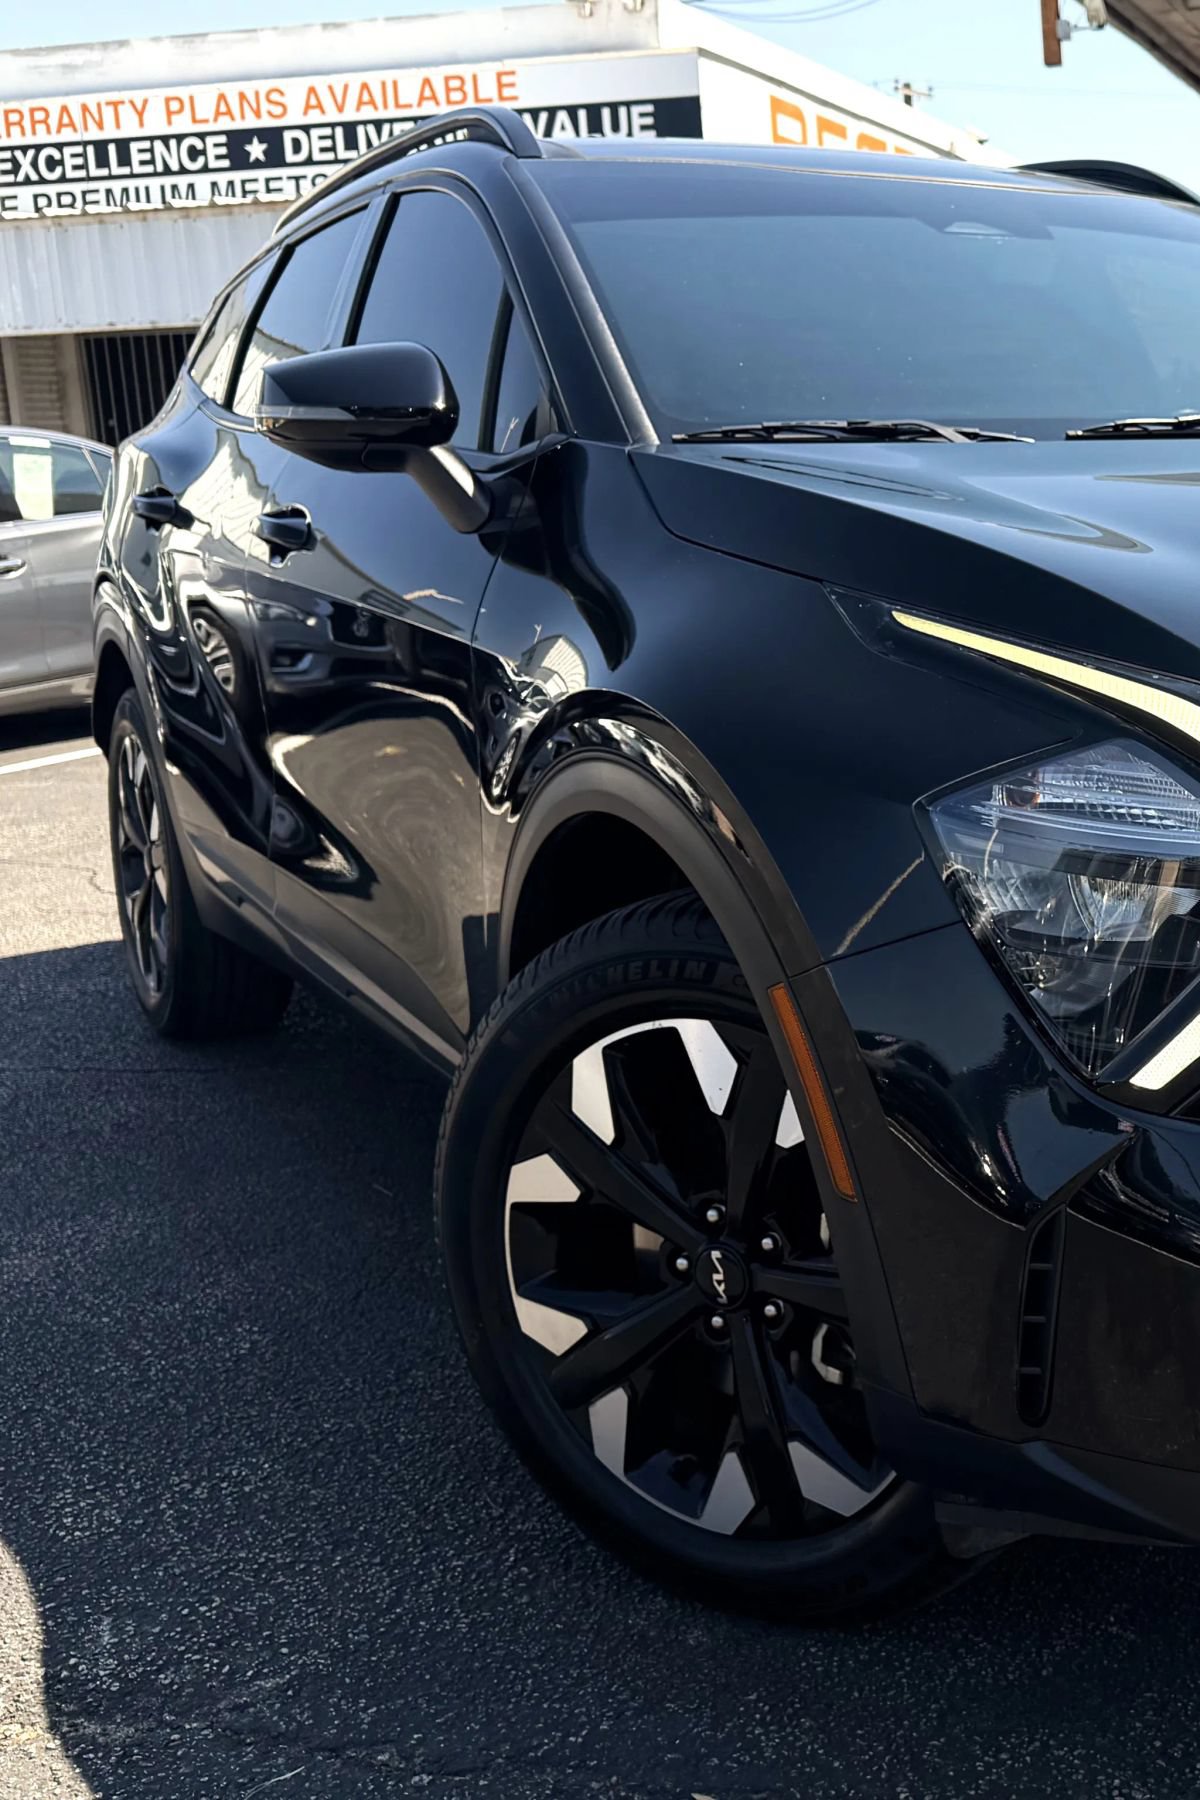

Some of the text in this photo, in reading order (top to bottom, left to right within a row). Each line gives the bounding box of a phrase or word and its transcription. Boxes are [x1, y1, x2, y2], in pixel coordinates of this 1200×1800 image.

[0, 70, 519, 139] RRANTY PLANS AVAILABLE
[0, 134, 231, 184] EXCELLENCE
[522, 104, 657, 137] VALUE
[33, 182, 196, 213] PREMIUM
